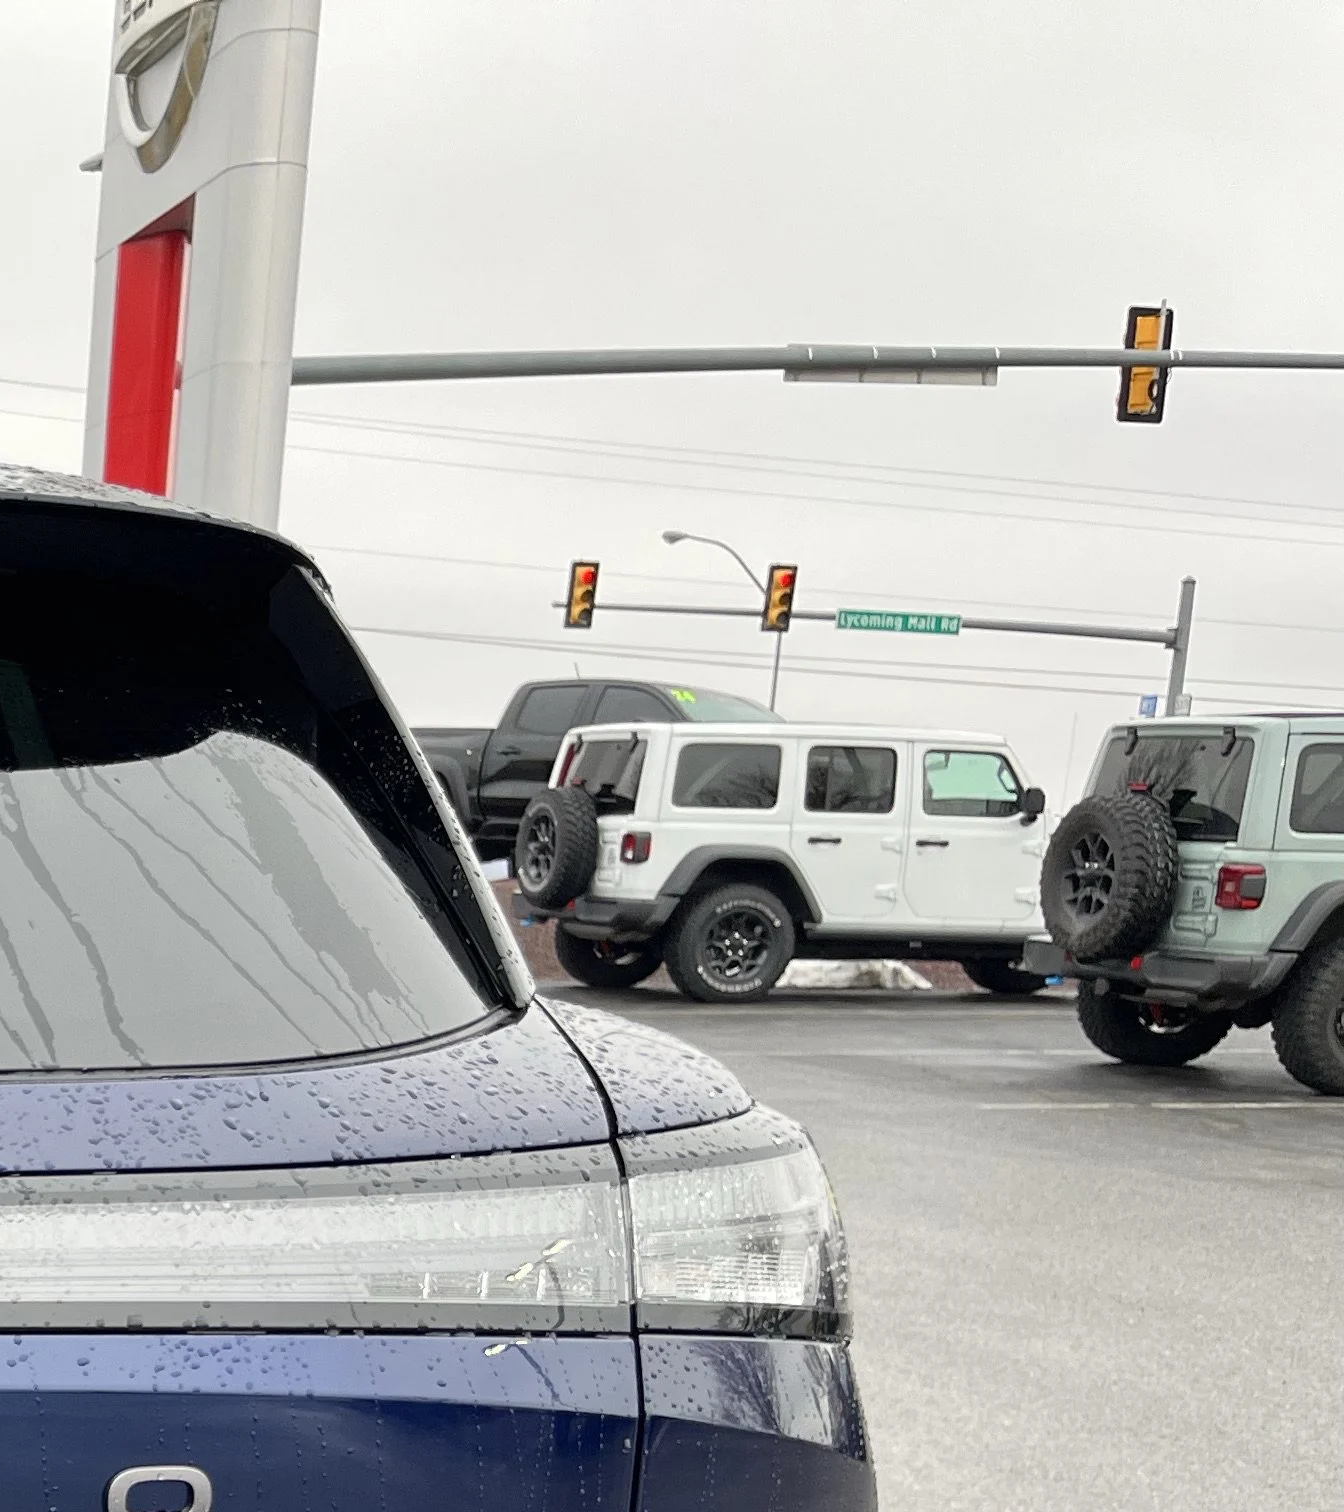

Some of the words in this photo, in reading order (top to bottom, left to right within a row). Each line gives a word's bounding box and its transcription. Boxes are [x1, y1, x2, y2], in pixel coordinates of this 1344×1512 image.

[840, 612, 903, 631] Lycoming
[907, 615, 936, 631] Mall
[940, 618, 959, 632] Rd
